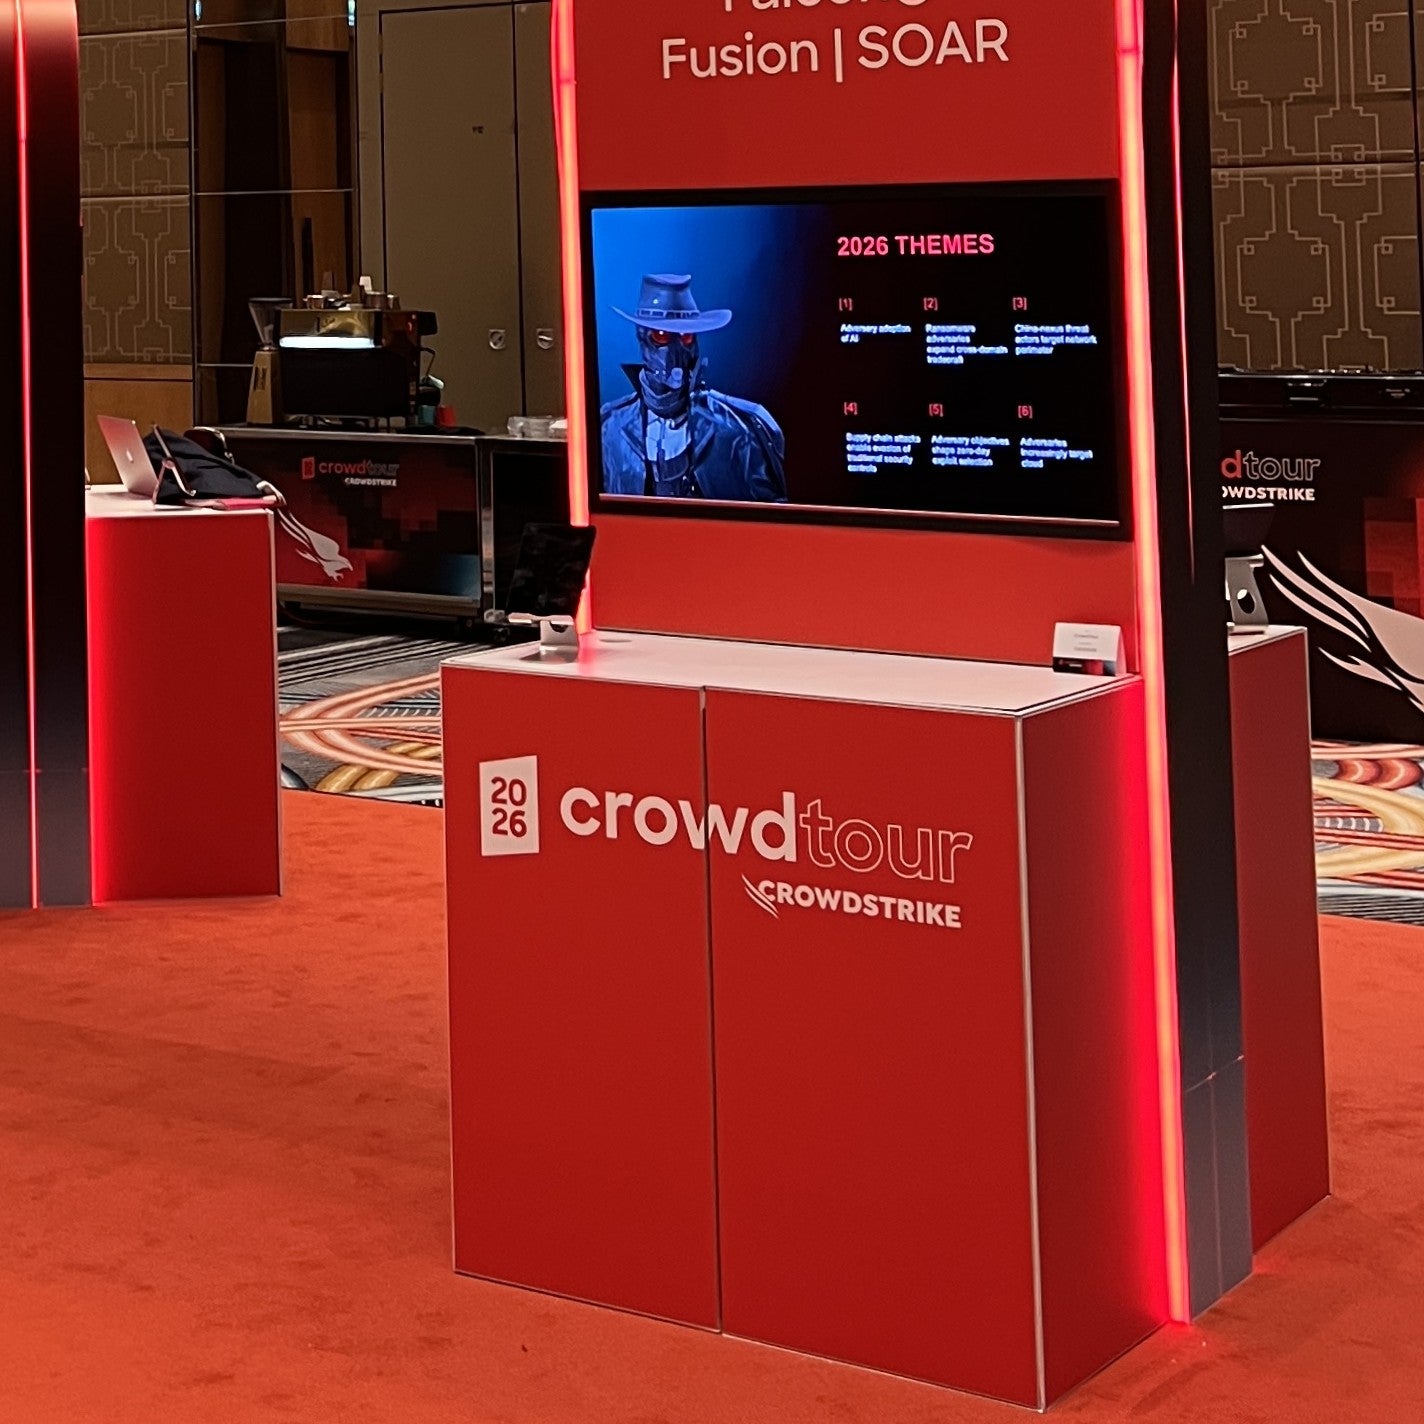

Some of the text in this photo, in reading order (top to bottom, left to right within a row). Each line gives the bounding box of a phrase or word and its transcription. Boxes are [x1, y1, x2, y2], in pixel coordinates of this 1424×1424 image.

[662, 31, 818, 79] Fusion
[858, 19, 1009, 69] SOAR
[837, 234, 994, 256] 2026 THEMES
[923, 297, 938, 311] [2]
[1012, 297, 1027, 311] [3]
[928, 403, 943, 417] [5]
[1017, 405, 1033, 419] [6]
[491, 808, 527, 838] 26
[491, 776, 973, 883] 20 crowdtour
[757, 879, 961, 929] CROWDSTRIKE
